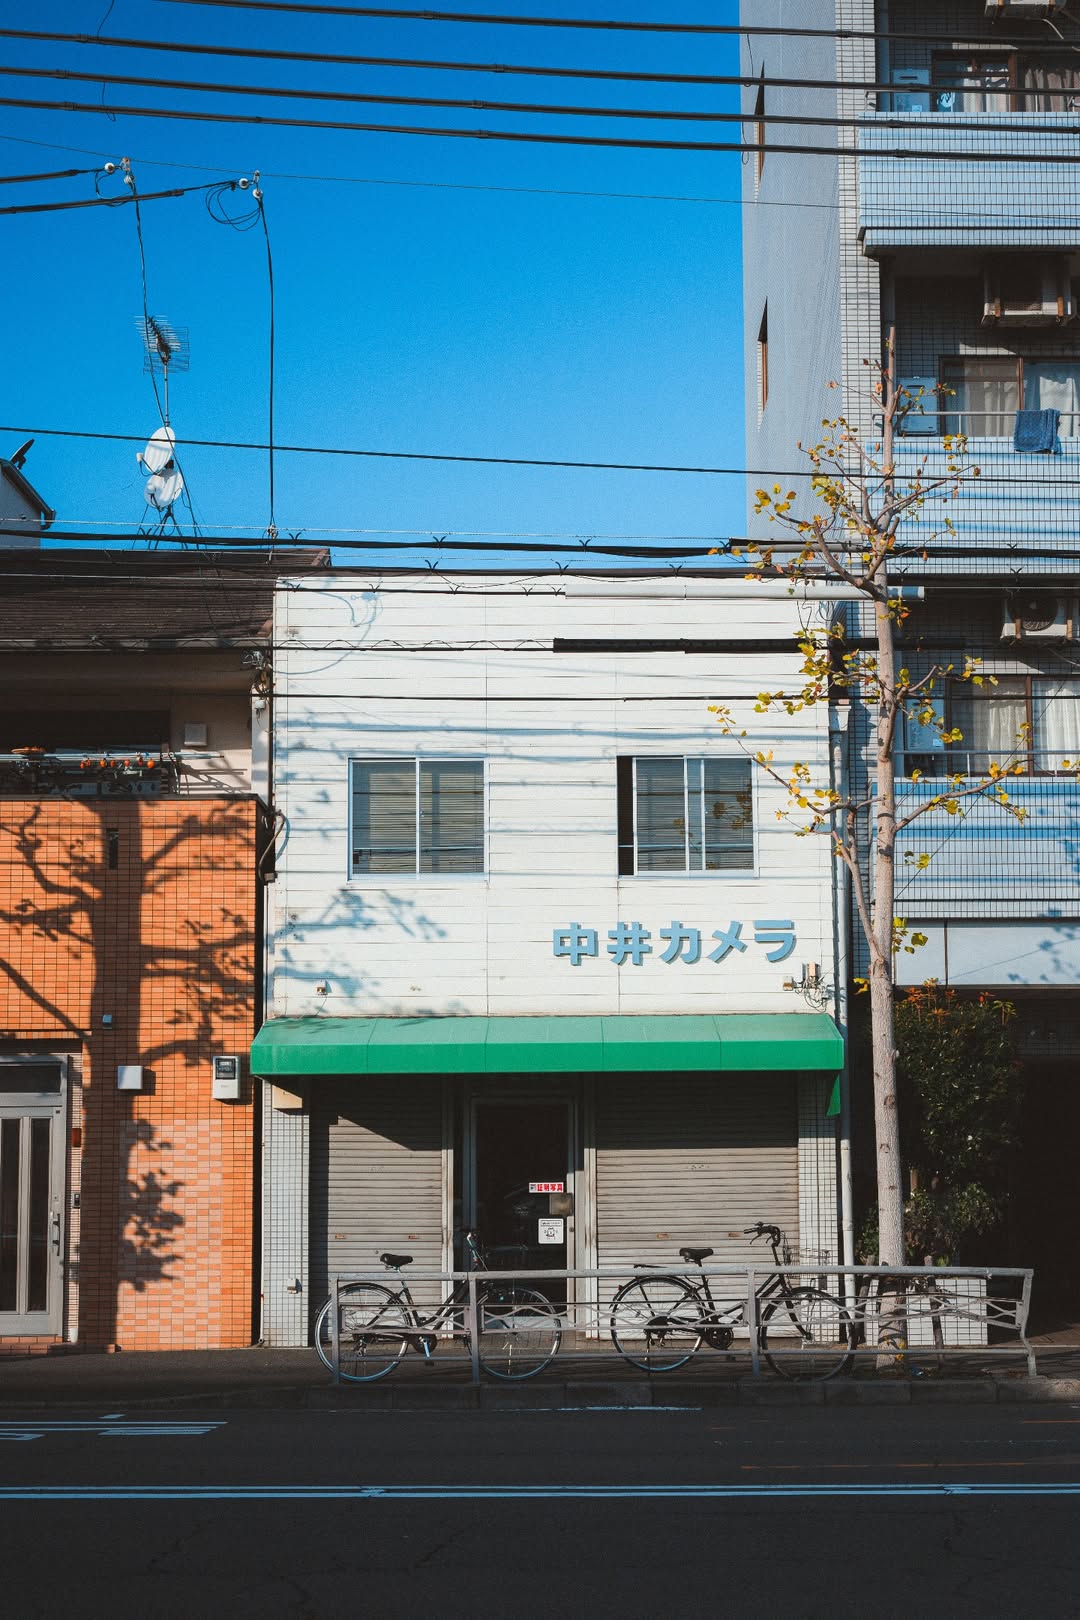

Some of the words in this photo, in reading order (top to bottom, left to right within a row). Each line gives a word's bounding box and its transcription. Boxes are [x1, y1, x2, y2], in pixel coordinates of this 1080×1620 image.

[553, 920, 797, 966] 中井カメラ
